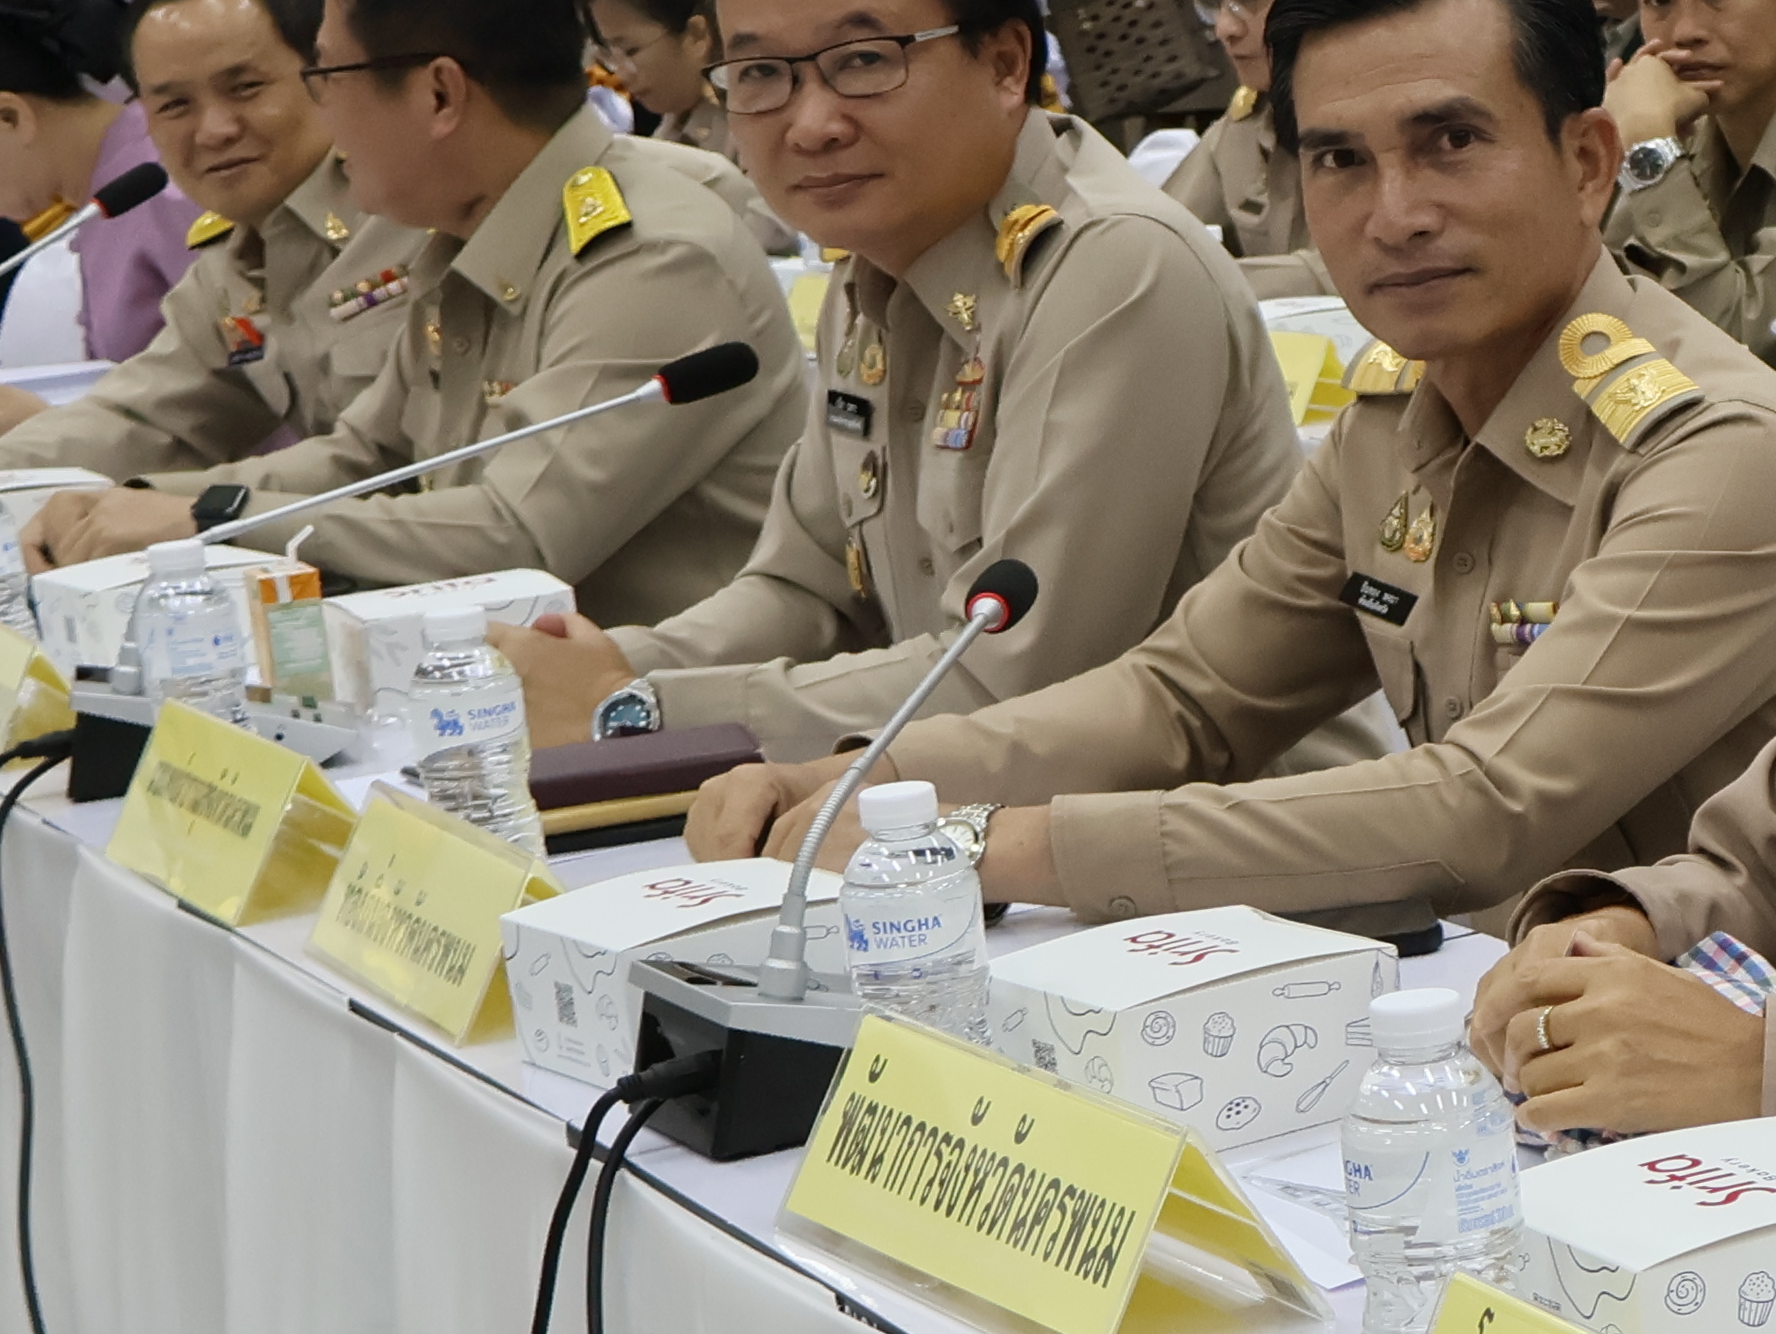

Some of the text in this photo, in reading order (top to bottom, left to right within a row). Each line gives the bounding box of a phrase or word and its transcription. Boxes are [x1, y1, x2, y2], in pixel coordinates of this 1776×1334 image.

[872, 914, 943, 937] SINGHA
[873, 930, 928, 951] WATER
[1123, 930, 1241, 967] Srifa
[827, 1054, 1136, 1288] พัฒนาการจังหวัดนครพนม
[1345, 1159, 1374, 1181] GHA
